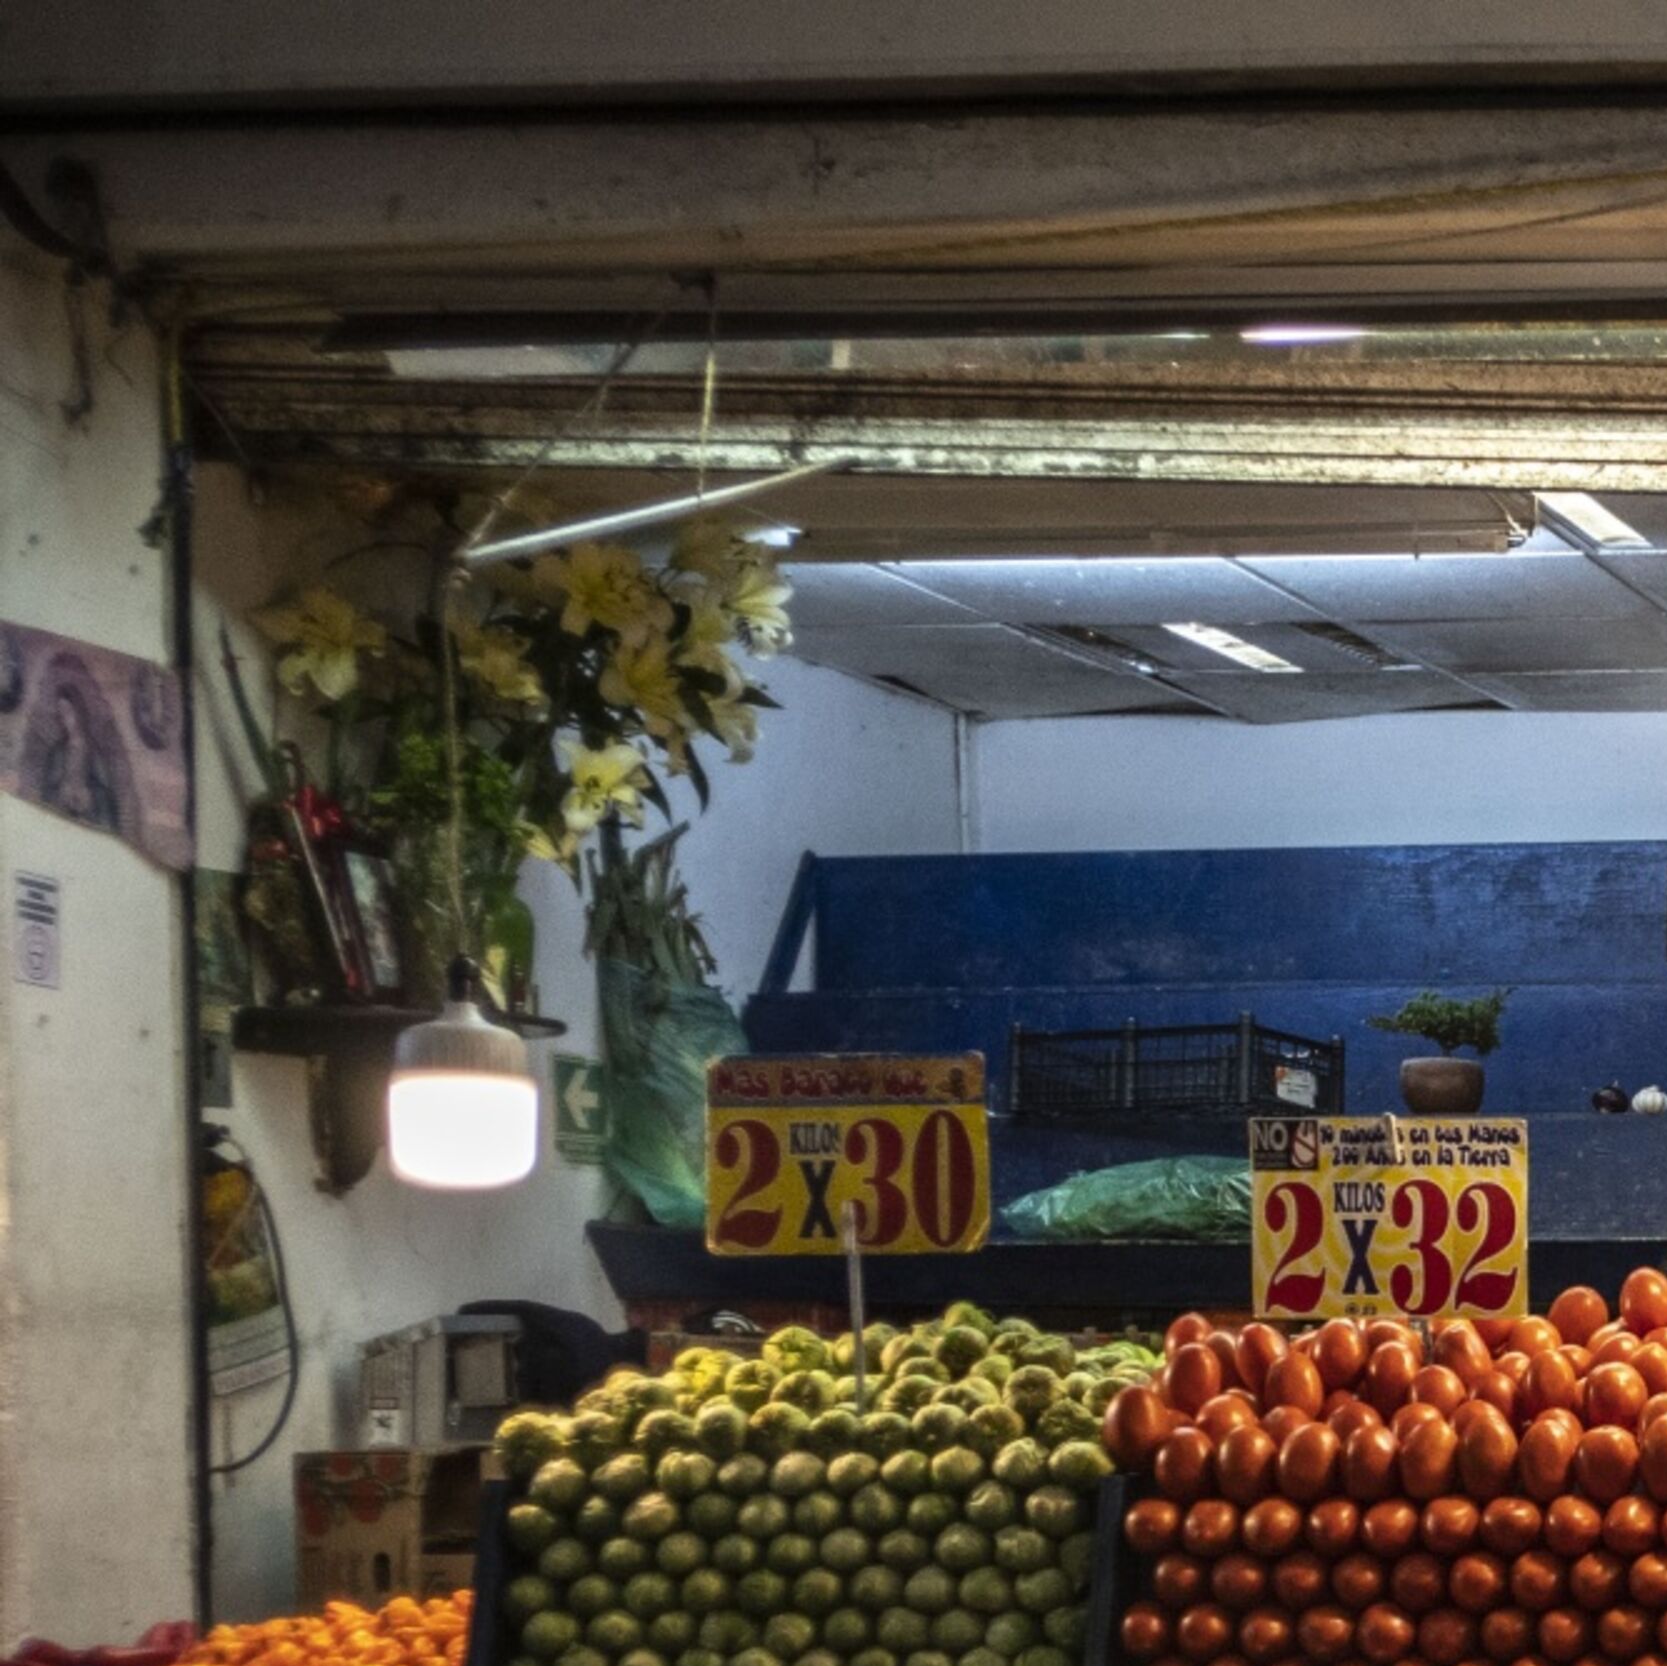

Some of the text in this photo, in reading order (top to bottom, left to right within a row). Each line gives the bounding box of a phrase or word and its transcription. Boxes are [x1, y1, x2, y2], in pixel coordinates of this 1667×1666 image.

[1253, 1121, 1289, 1152] NO
[715, 1109, 976, 1249] 2 X 30
[1333, 1182, 1386, 1213] KILOS
[1264, 1179, 1519, 1316] 2 X 32
